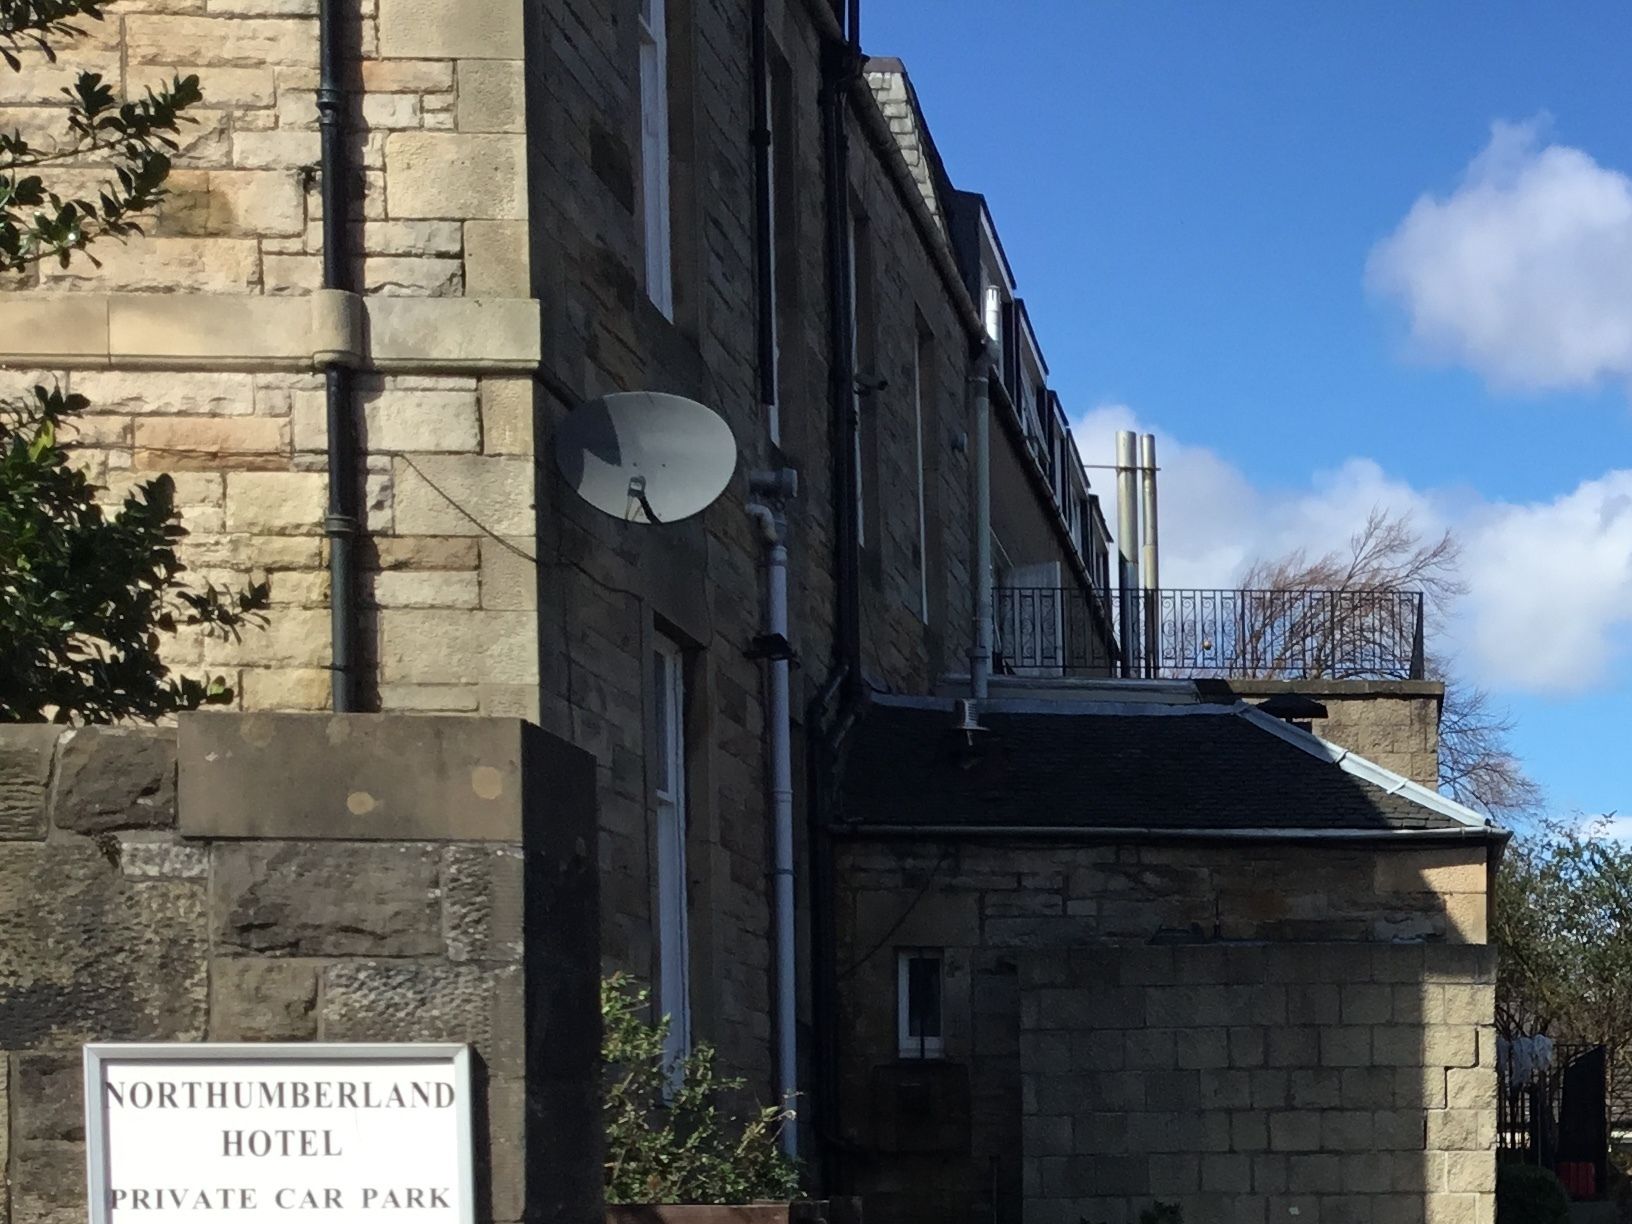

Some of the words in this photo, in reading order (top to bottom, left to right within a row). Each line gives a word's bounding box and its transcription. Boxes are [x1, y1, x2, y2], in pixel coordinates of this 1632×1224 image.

[106, 1081, 455, 1110] NORTHUMBERLAND
[222, 1130, 343, 1157] HOTEL
[111, 1188, 258, 1210] PRIVATE
[275, 1188, 345, 1209] CAR
[362, 1187, 452, 1209] PARK
